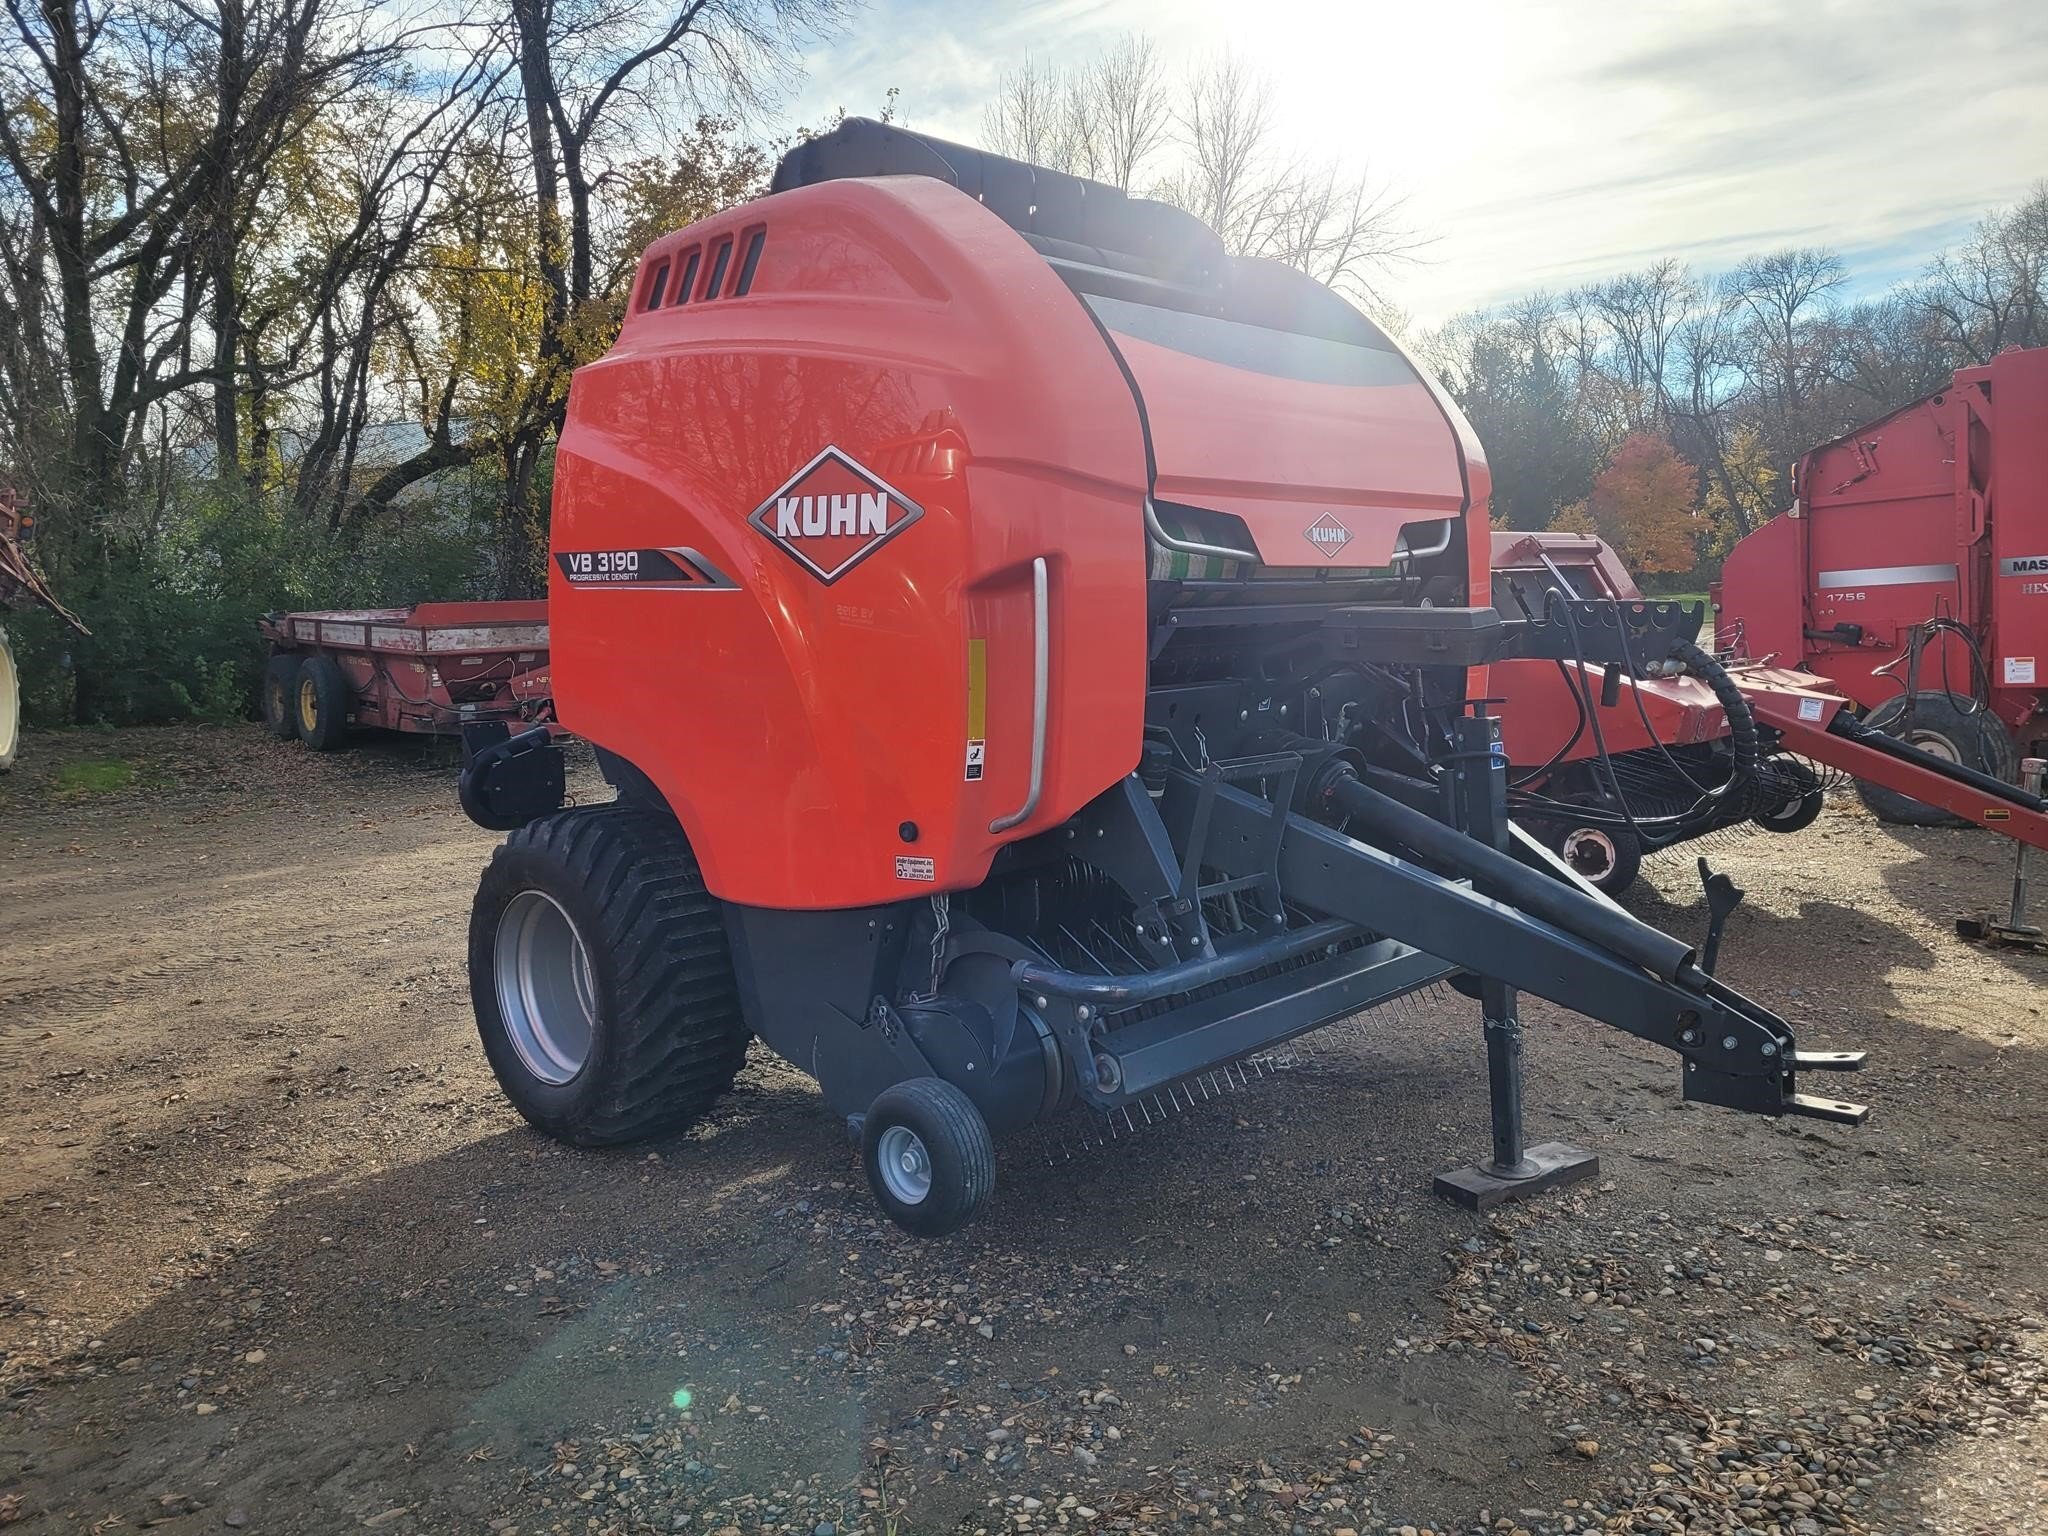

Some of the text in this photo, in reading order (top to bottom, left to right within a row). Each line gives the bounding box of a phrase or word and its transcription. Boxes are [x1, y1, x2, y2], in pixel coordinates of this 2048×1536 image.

[777, 492, 888, 537] KUHN
[1312, 527, 1345, 542] KUHN
[569, 551, 639, 572] VB 3190
[2013, 559, 2048, 571] MAS
[1826, 592, 1866, 602] 1756
